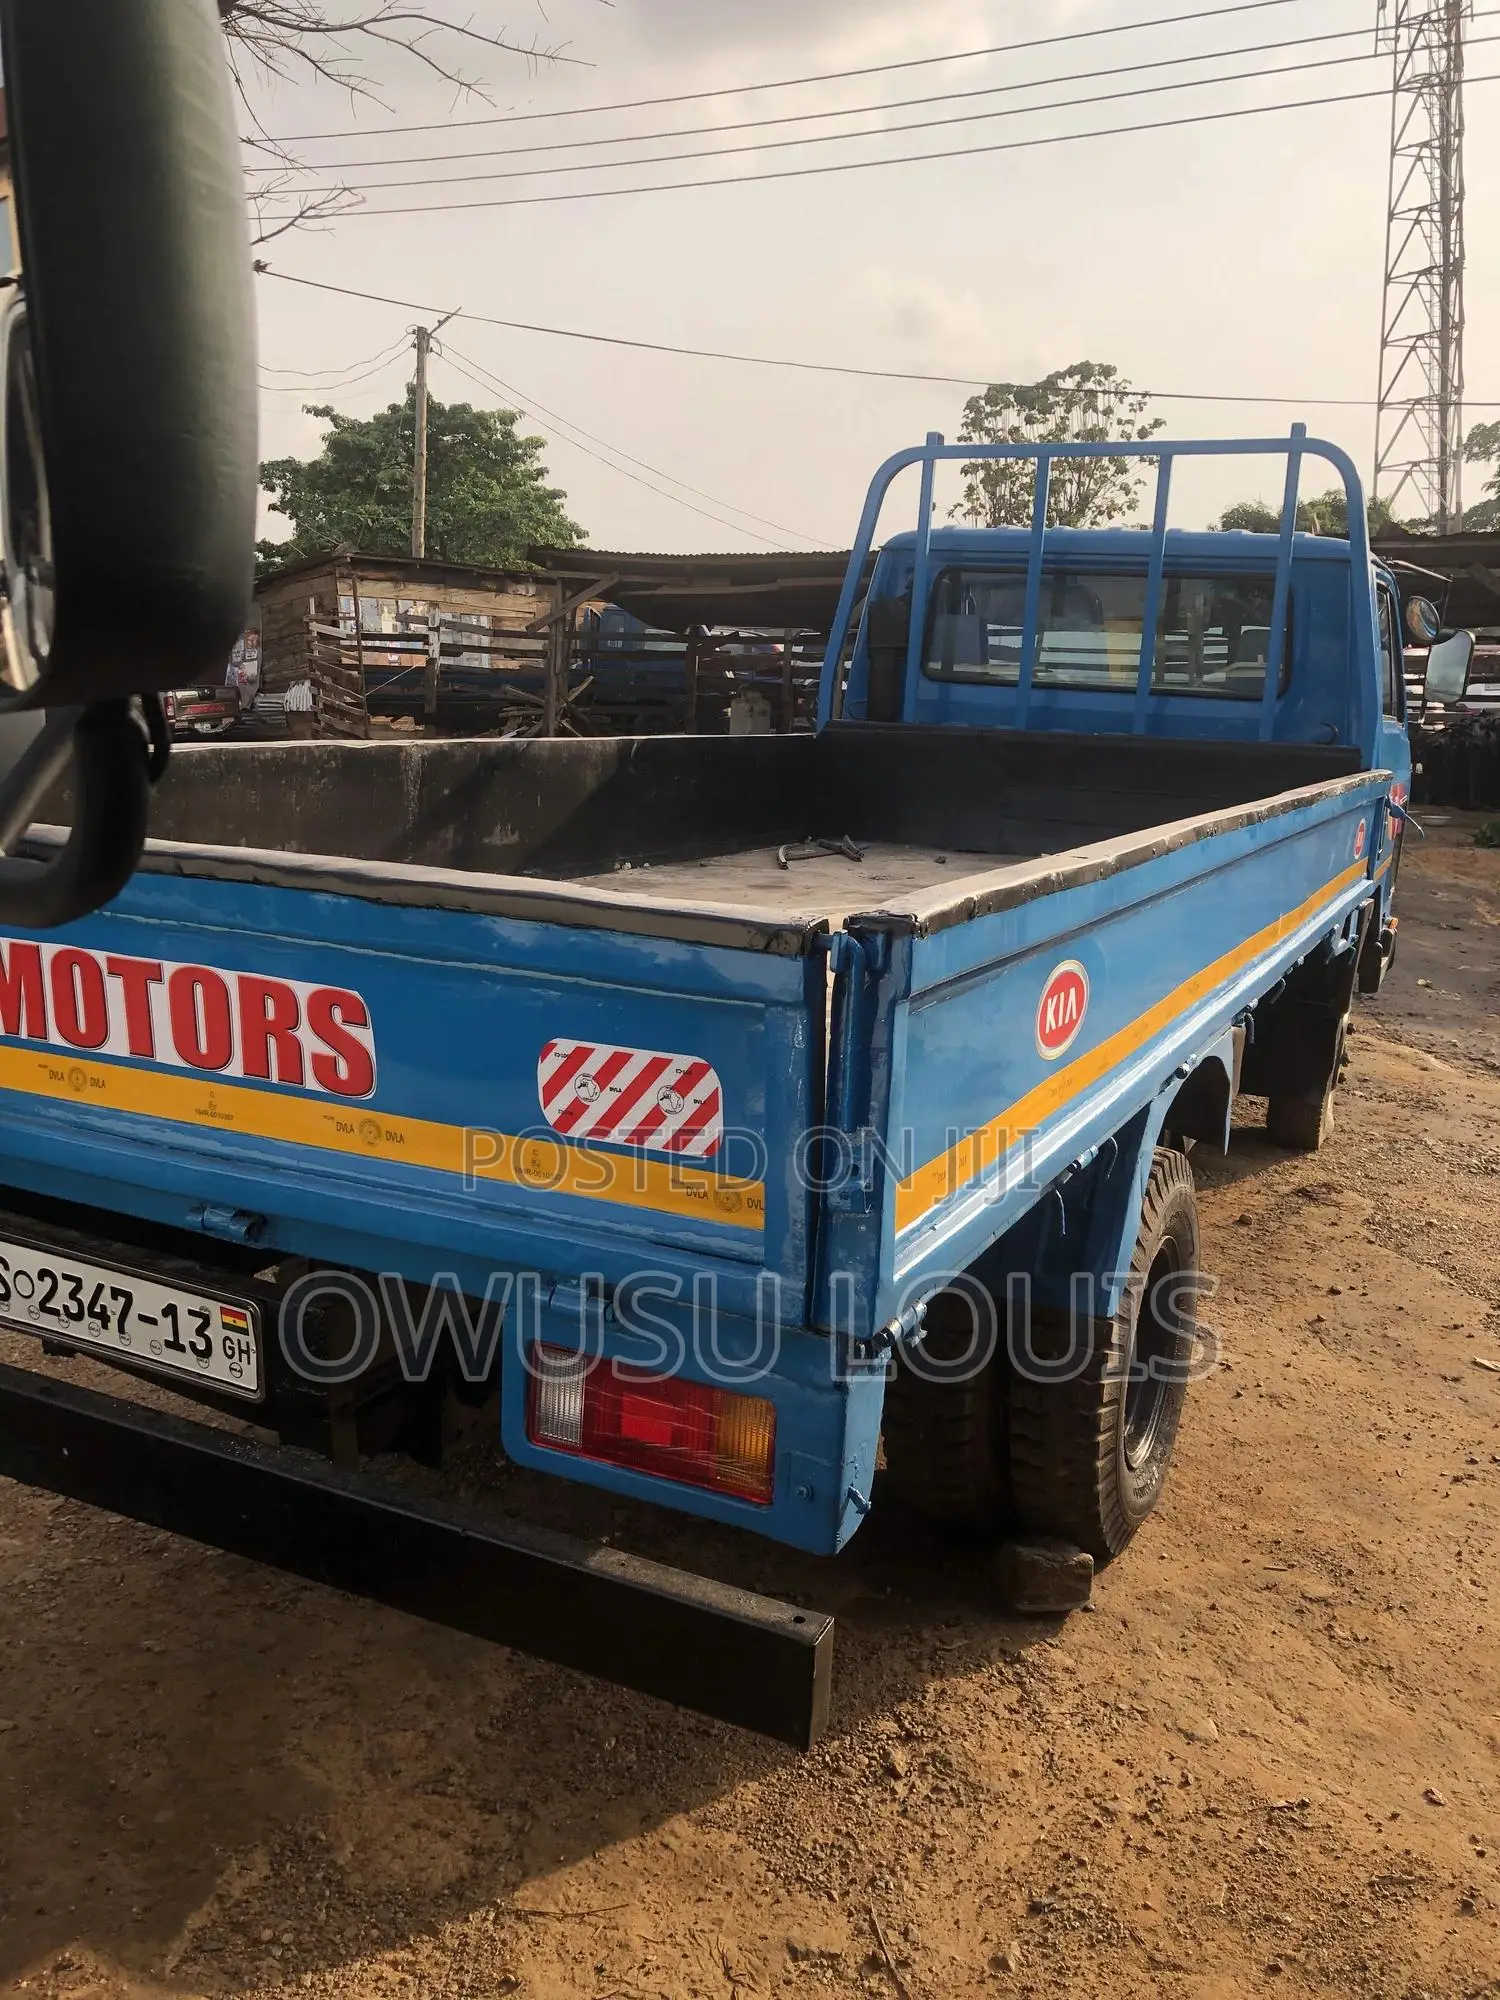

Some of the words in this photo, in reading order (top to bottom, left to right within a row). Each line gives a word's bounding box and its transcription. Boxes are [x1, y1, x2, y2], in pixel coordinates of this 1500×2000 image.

[0, 941, 374, 1099] MOTORS
[1045, 987, 1077, 1034] KIA
[49, 1069, 65, 1081] DVLA
[90, 1076, 105, 1089] DVLA
[336, 1121, 355, 1134] DVLA
[385, 1130, 405, 1144] DVLA
[686, 1186, 709, 1200] DVLA
[37, 1267, 213, 1359] 2347-13
[222, 1335, 251, 1365] GH
